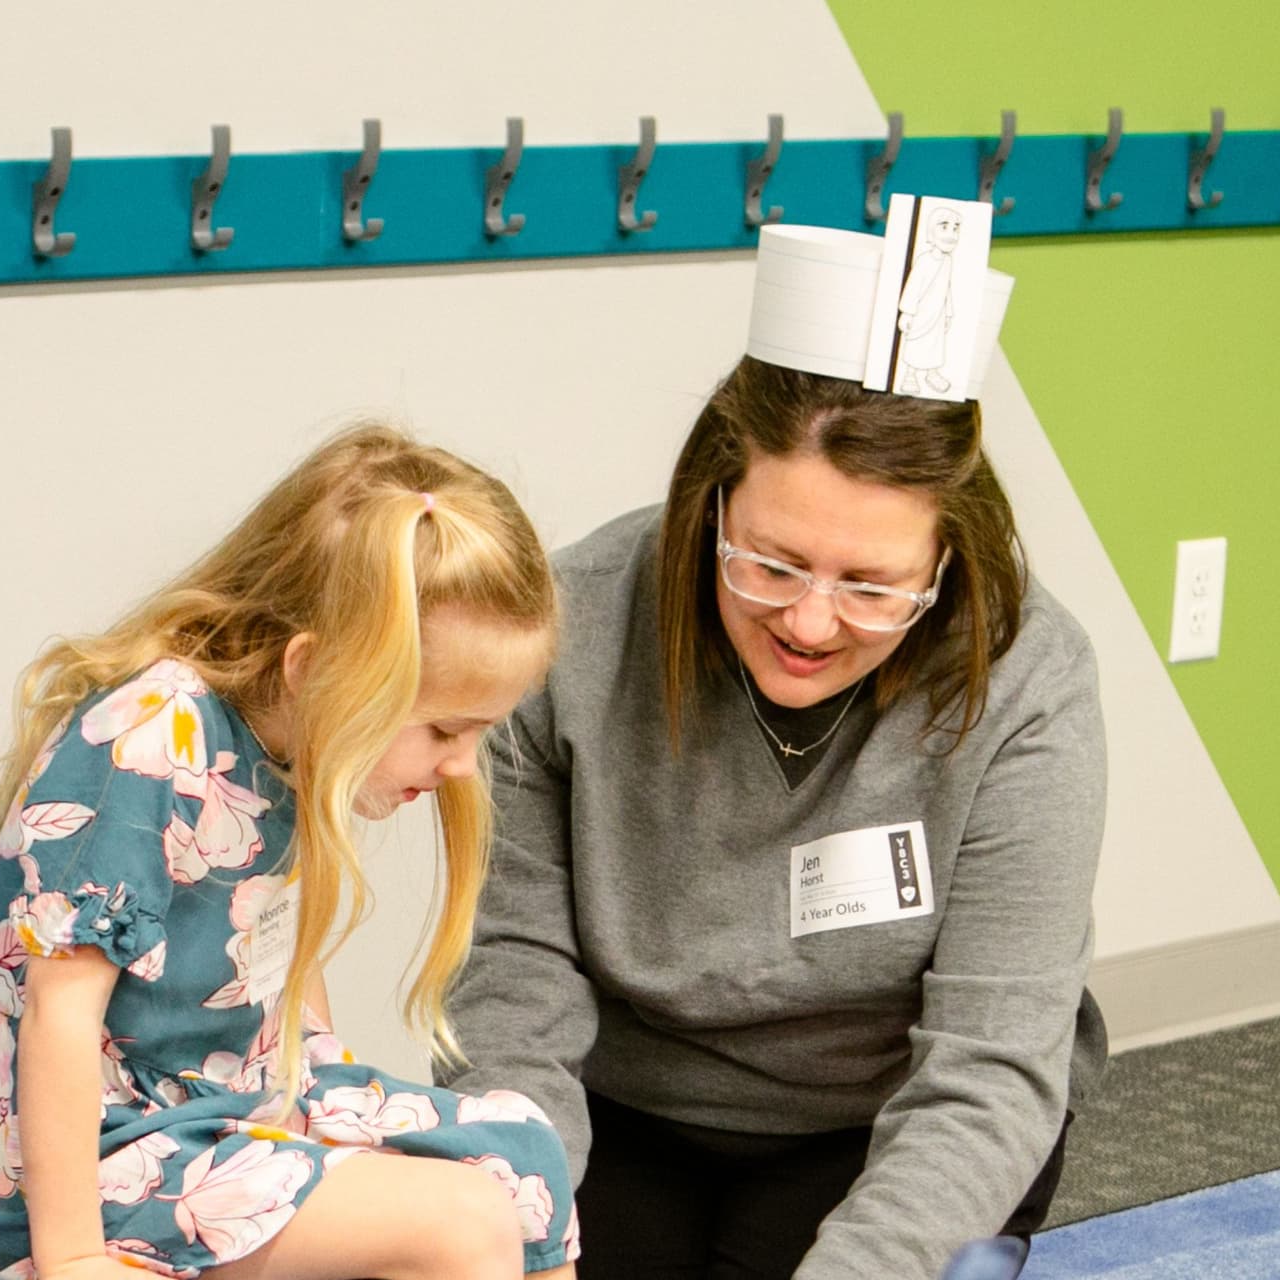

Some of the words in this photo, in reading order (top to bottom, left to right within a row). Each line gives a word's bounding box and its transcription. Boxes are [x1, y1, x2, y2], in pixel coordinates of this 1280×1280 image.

[800, 856, 821, 873] Jen
[800, 873, 824, 888] Horst
[800, 911, 807, 922] 4
[809, 907, 833, 920] Year
[836, 901, 867, 915] Olds
